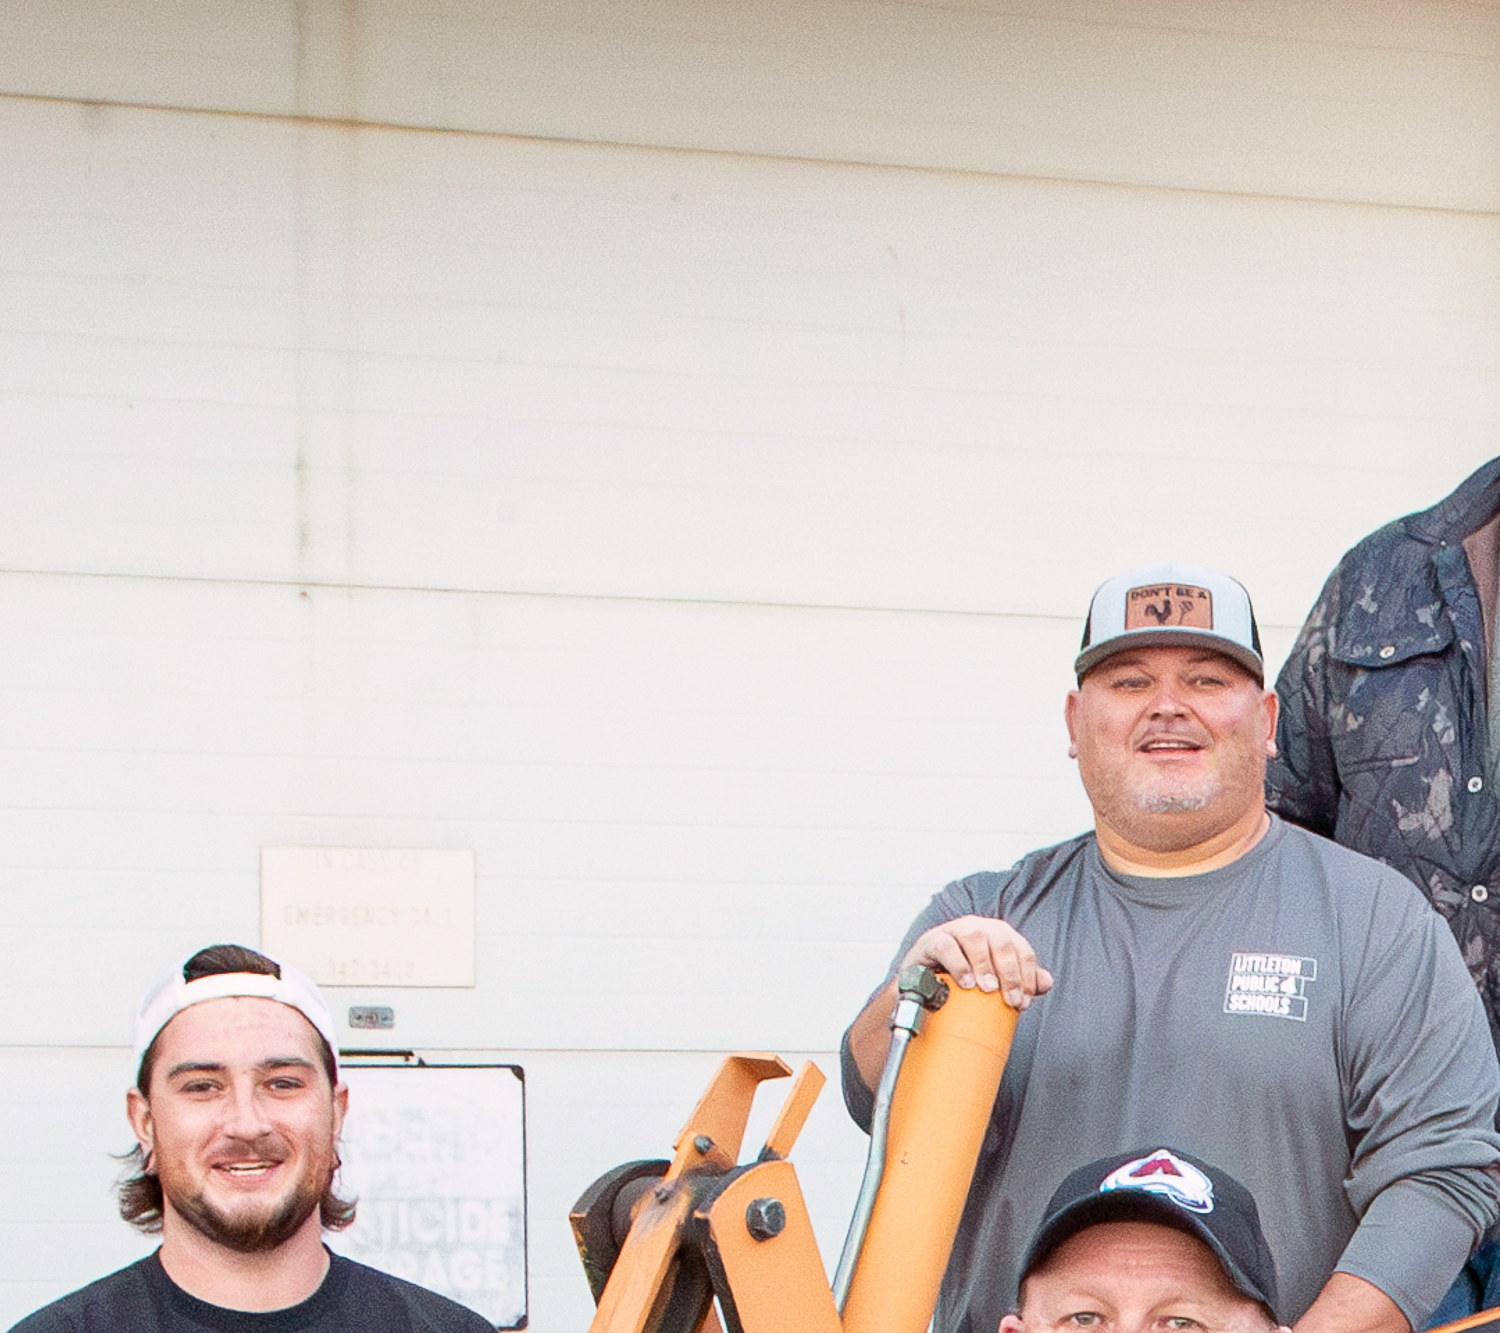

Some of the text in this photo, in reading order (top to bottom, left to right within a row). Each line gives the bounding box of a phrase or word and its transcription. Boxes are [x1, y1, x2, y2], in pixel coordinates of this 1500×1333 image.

[1234, 956, 1302, 974] LITTLETON
[1231, 975, 1280, 993] PUBLIC
[1228, 995, 1291, 1015] SCHOOLS
[352, 1199, 511, 1245] STICIDE
